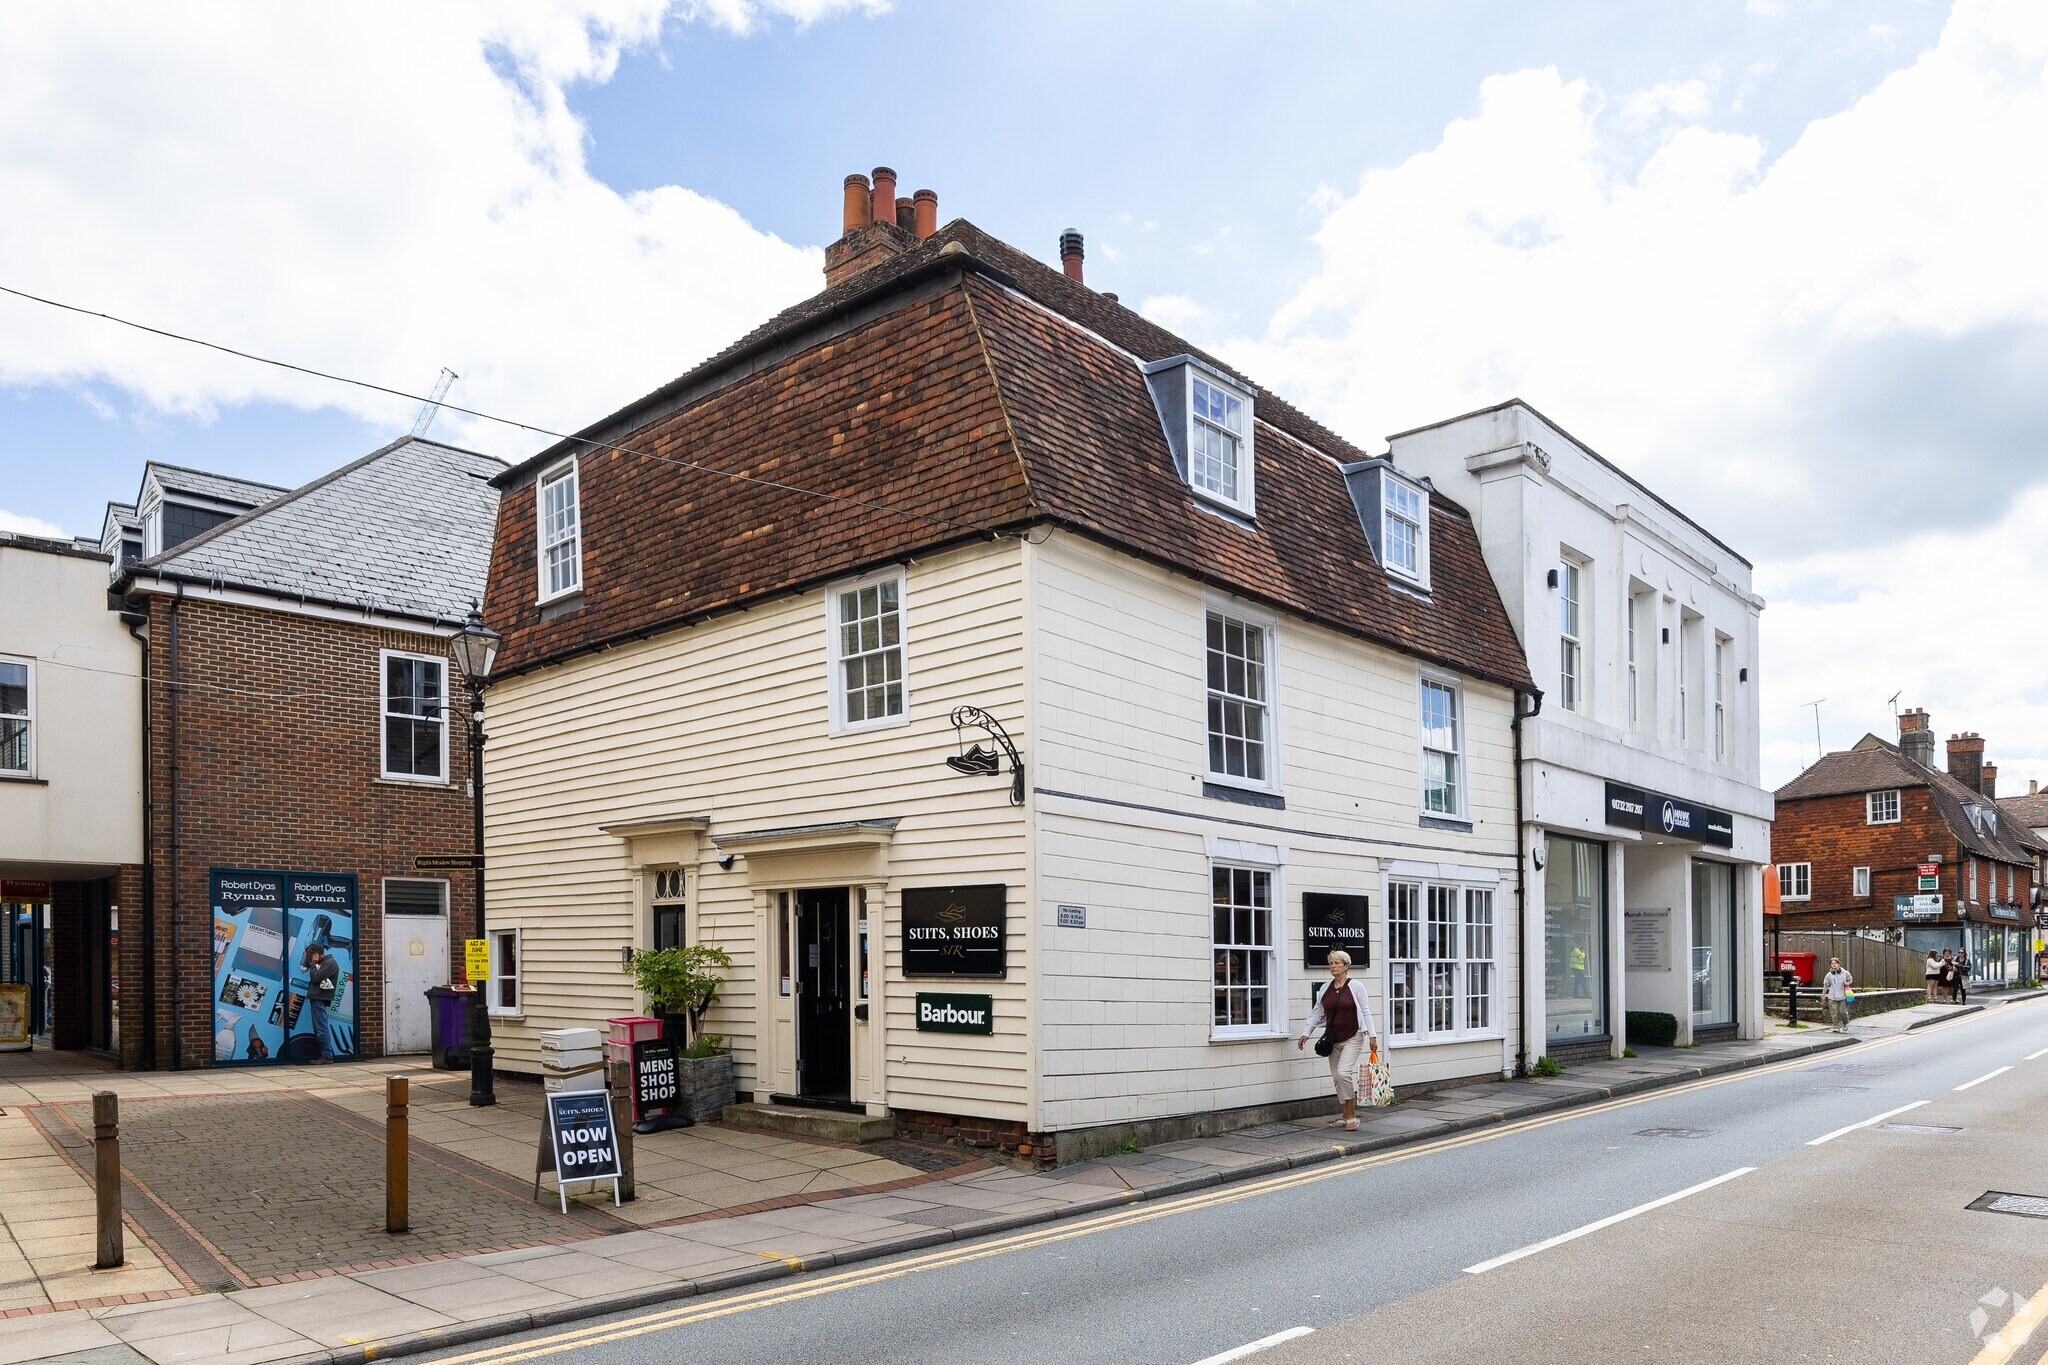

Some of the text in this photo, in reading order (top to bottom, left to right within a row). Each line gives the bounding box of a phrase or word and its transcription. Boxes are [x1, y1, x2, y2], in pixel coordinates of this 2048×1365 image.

[221, 880, 276, 892] Robert Dyas
[294, 882, 346, 894] Robert Dyas
[221, 891, 276, 902] Ryman
[294, 893, 346, 903] Ryman
[909, 926, 998, 941] SUITS, SHOES
[1308, 926, 1365, 938] SUITS, SHOES
[940, 944, 967, 958] SIR
[1780, 963, 1796, 971] Biffa
[330, 971, 349, 1012] Pukka Pad
[640, 1058, 674, 1074] MENS
[640, 1072, 675, 1088] SHOE
[641, 1085, 676, 1102] SHOP
[561, 1126, 607, 1145] NOW
[562, 1147, 612, 1166] OPEN
